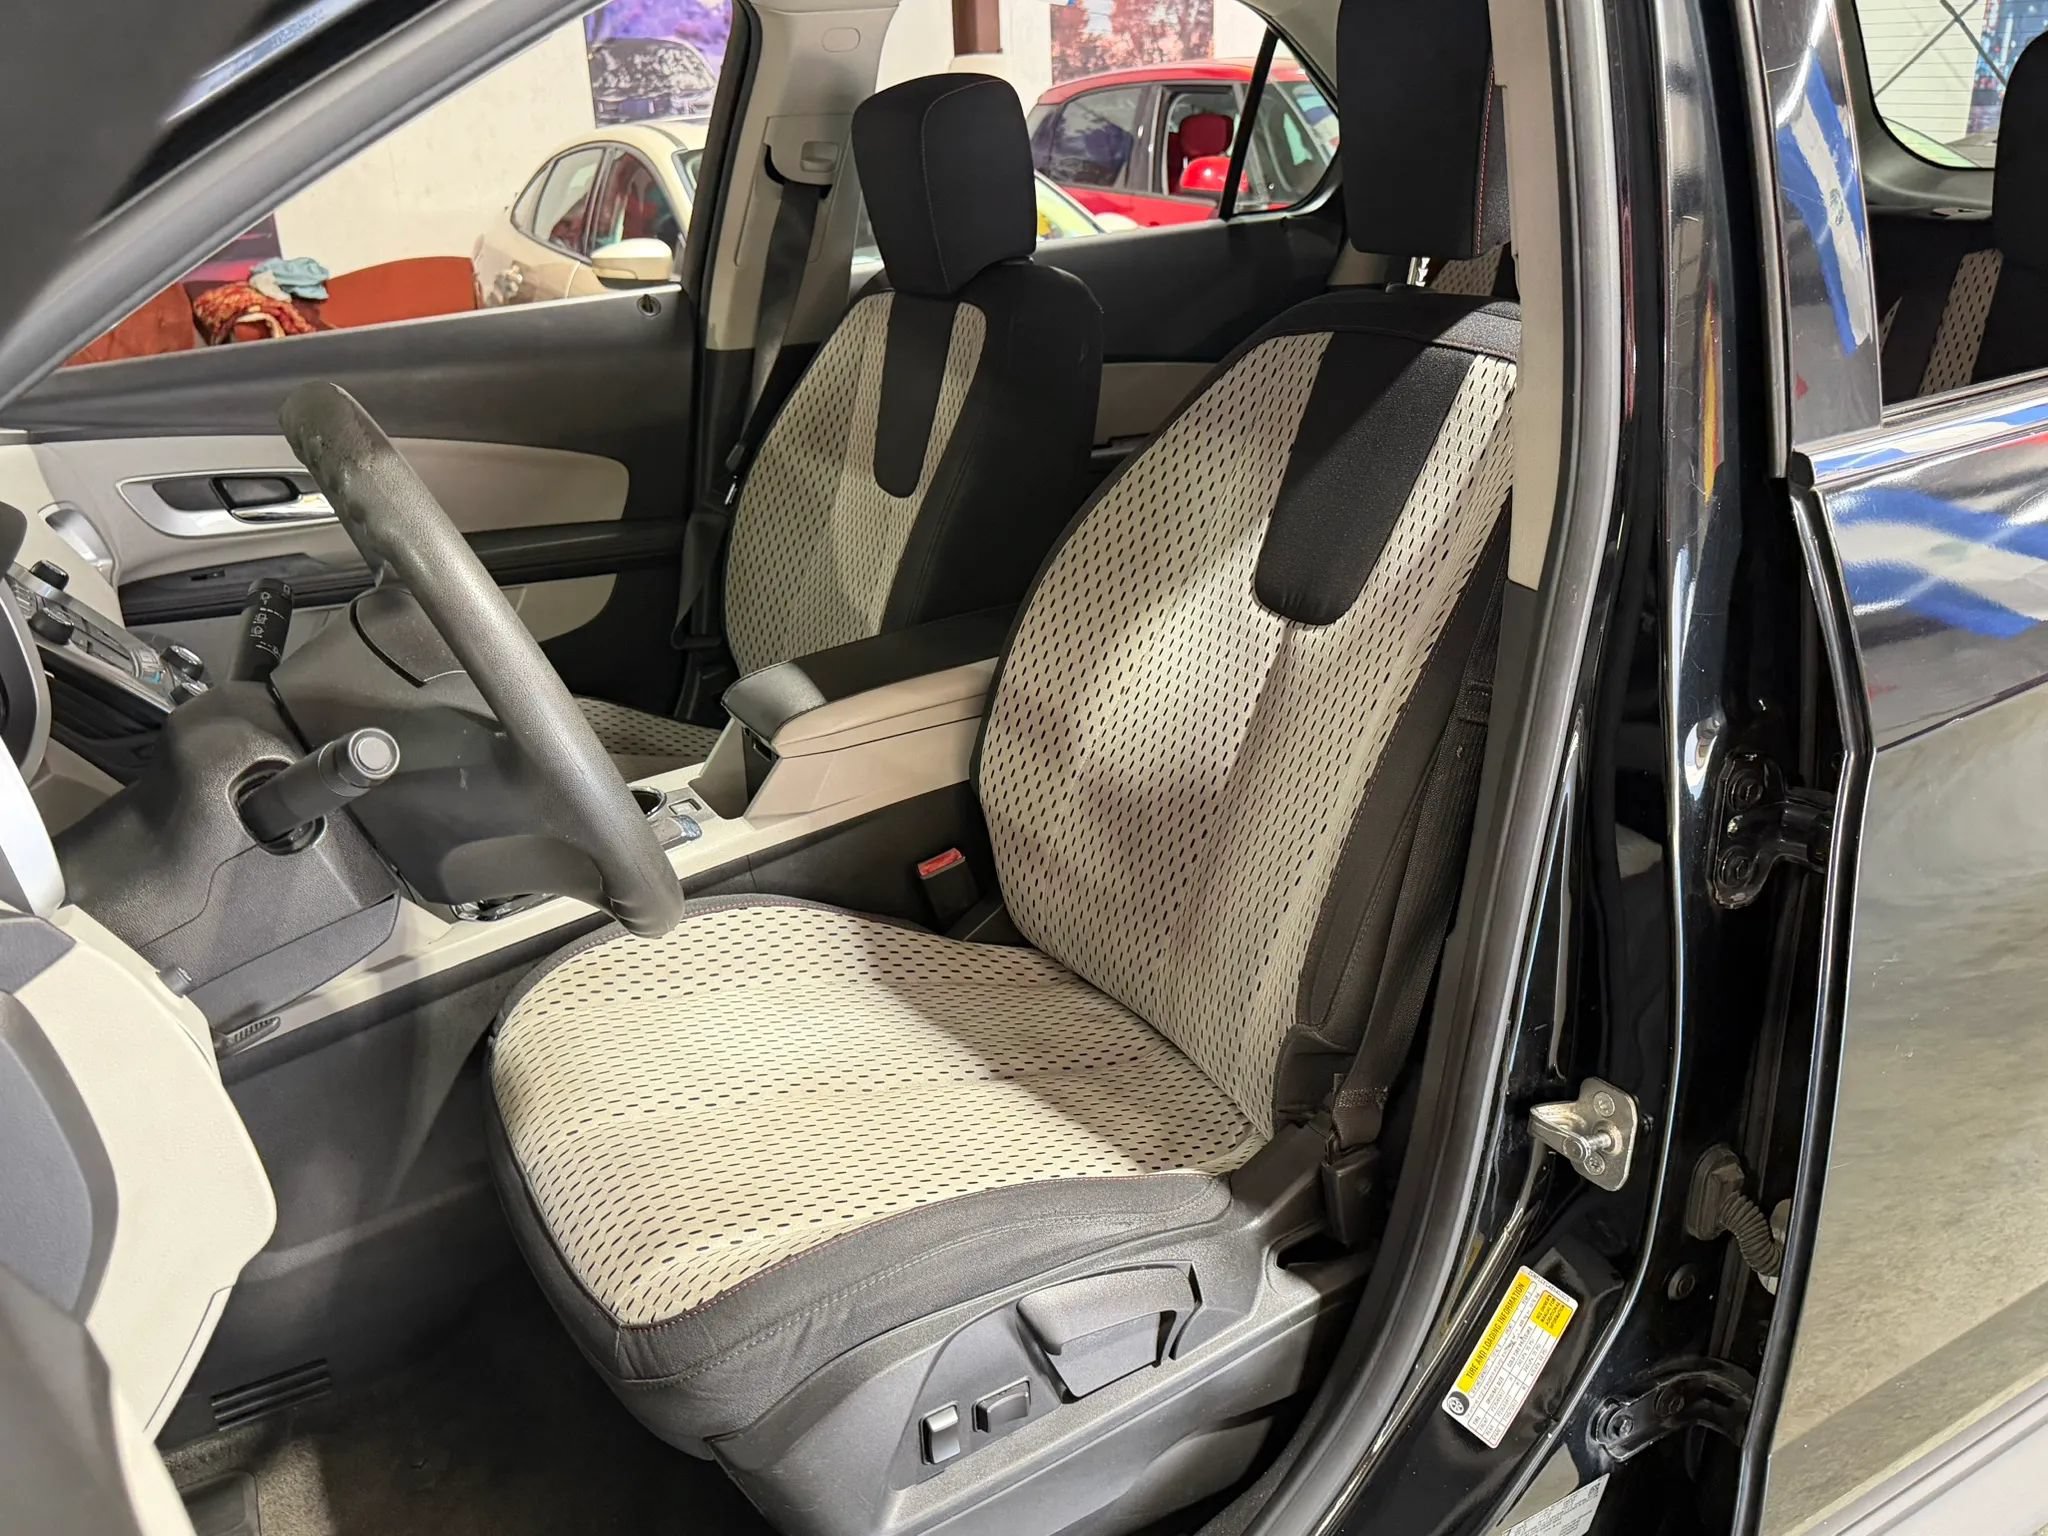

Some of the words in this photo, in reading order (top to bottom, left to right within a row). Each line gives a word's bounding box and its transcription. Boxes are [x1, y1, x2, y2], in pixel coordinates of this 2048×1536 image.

[1465, 1363, 1478, 1379] TIRE
[1473, 1348, 1486, 1365] AND
[1481, 1322, 1501, 1351] LOADING
[1497, 1281, 1525, 1324] INFORMATION
